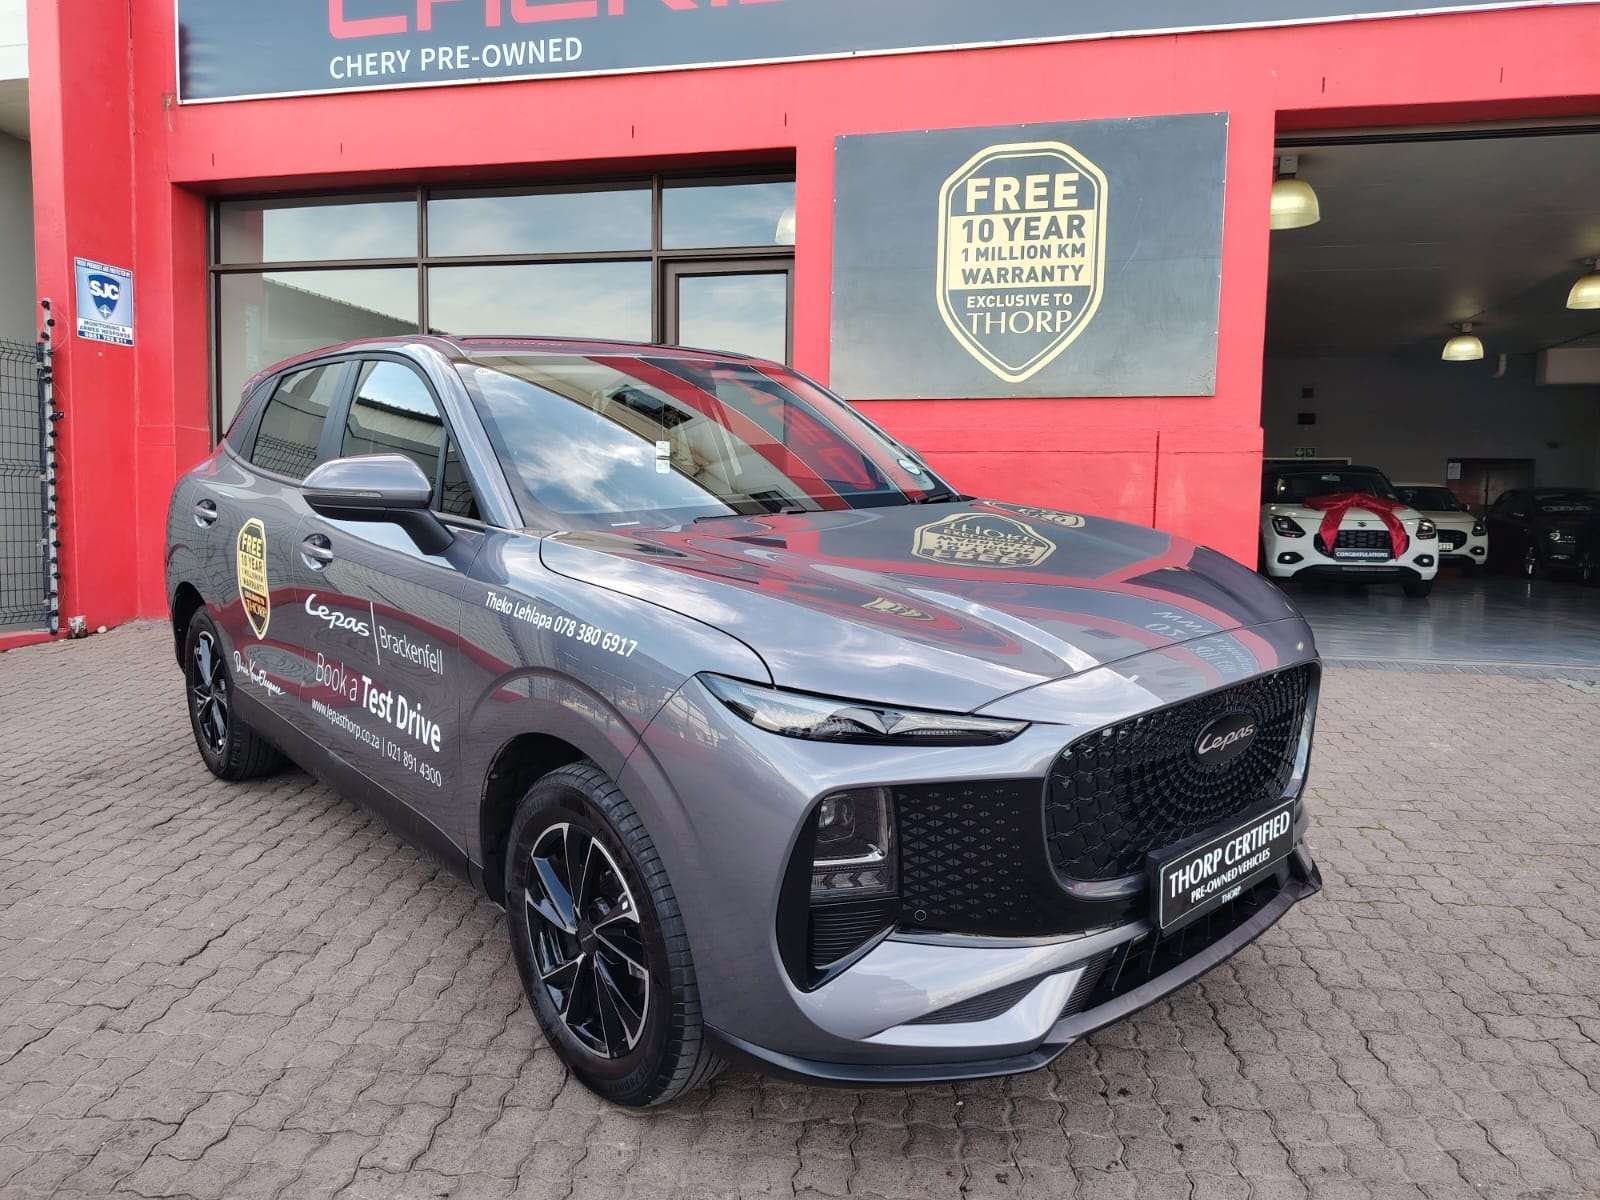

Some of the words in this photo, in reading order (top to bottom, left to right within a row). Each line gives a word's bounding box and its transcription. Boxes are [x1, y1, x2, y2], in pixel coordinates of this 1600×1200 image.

[329, 49, 411, 79] CHERY
[421, 37, 582, 71] PRE-OWNED
[966, 172, 1080, 213] FREE
[961, 218, 994, 244] 10
[1003, 214, 1086, 242] YEAR
[961, 247, 969, 262] 1
[975, 244, 1051, 262] MILLION
[1057, 242, 1086, 259] KM
[89, 280, 120, 300] SJC
[961, 264, 1084, 285] WARRANTY
[966, 293, 1049, 309] EXCLUSIVE
[1053, 293, 1073, 306] TO
[967, 310, 1073, 335] THORP
[241, 533, 262, 558] FREE
[248, 556, 263, 573] YEAR
[304, 593, 370, 637] Lepas
[485, 591, 513, 615] Theko
[513, 601, 553, 631] Lehlapa
[553, 615, 577, 638] 078
[576, 623, 601, 646] 380
[601, 632, 638, 658] 6917
[379, 625, 444, 676] Brackenfell
[315, 652, 348, 697] Book
[349, 678, 358, 702] a
[362, 675, 393, 724] Test
[396, 694, 441, 753] Drive
[311, 698, 380, 749] www.lepasthorp.co.za
[387, 741, 401, 762] 021
[403, 751, 417, 773] 891
[419, 762, 442, 787] 4300
[1198, 722, 1255, 755] Lepas
[1169, 846, 1223, 898] THORP
[1224, 810, 1290, 866] CERTIFIED
[1190, 866, 1238, 904] PRE-OWNED
[1237, 848, 1271, 876] VEHICLES
[1221, 885, 1242, 904] THORP
